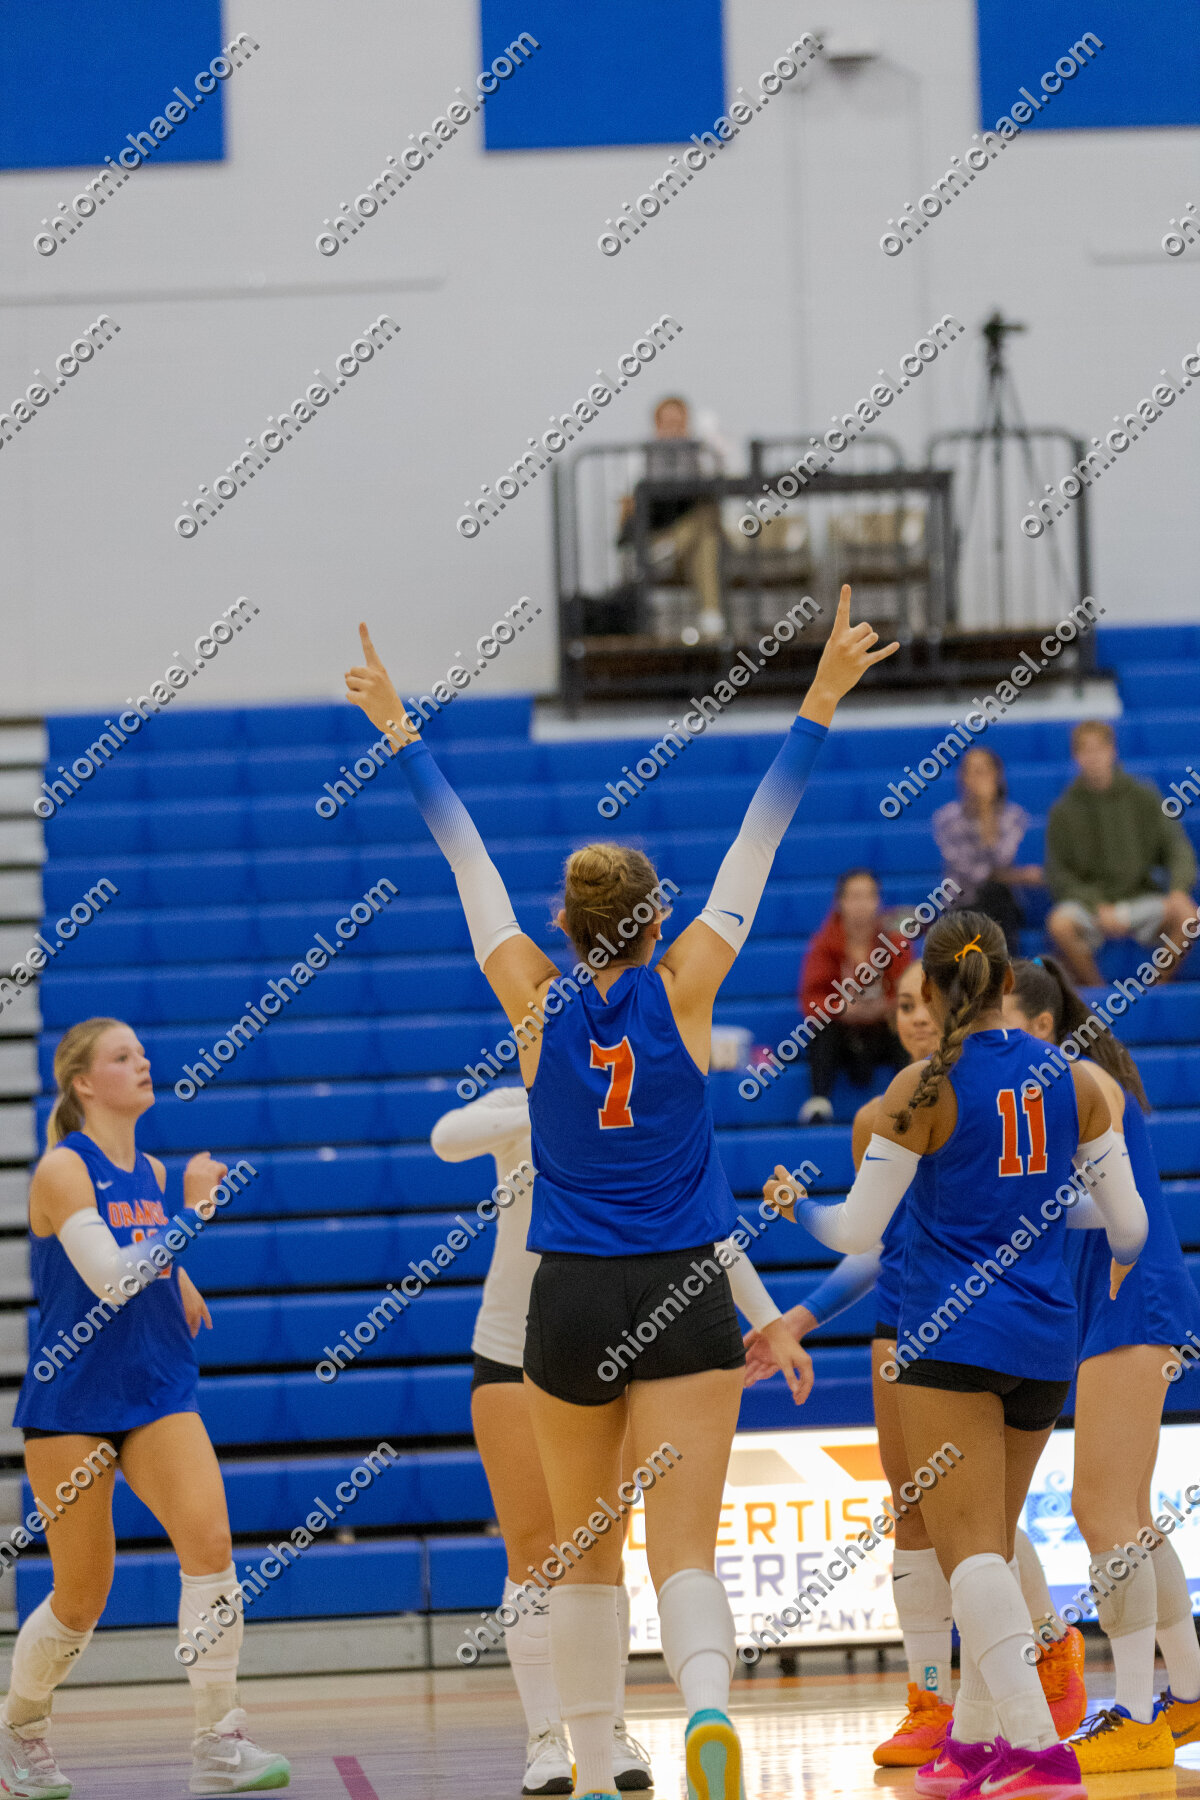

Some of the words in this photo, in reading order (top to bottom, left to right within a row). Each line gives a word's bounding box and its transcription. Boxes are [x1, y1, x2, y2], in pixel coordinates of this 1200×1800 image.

[589, 1035, 636, 1130] 7
[996, 1088, 1048, 1177] 11
[716, 1552, 825, 1598] ERE
